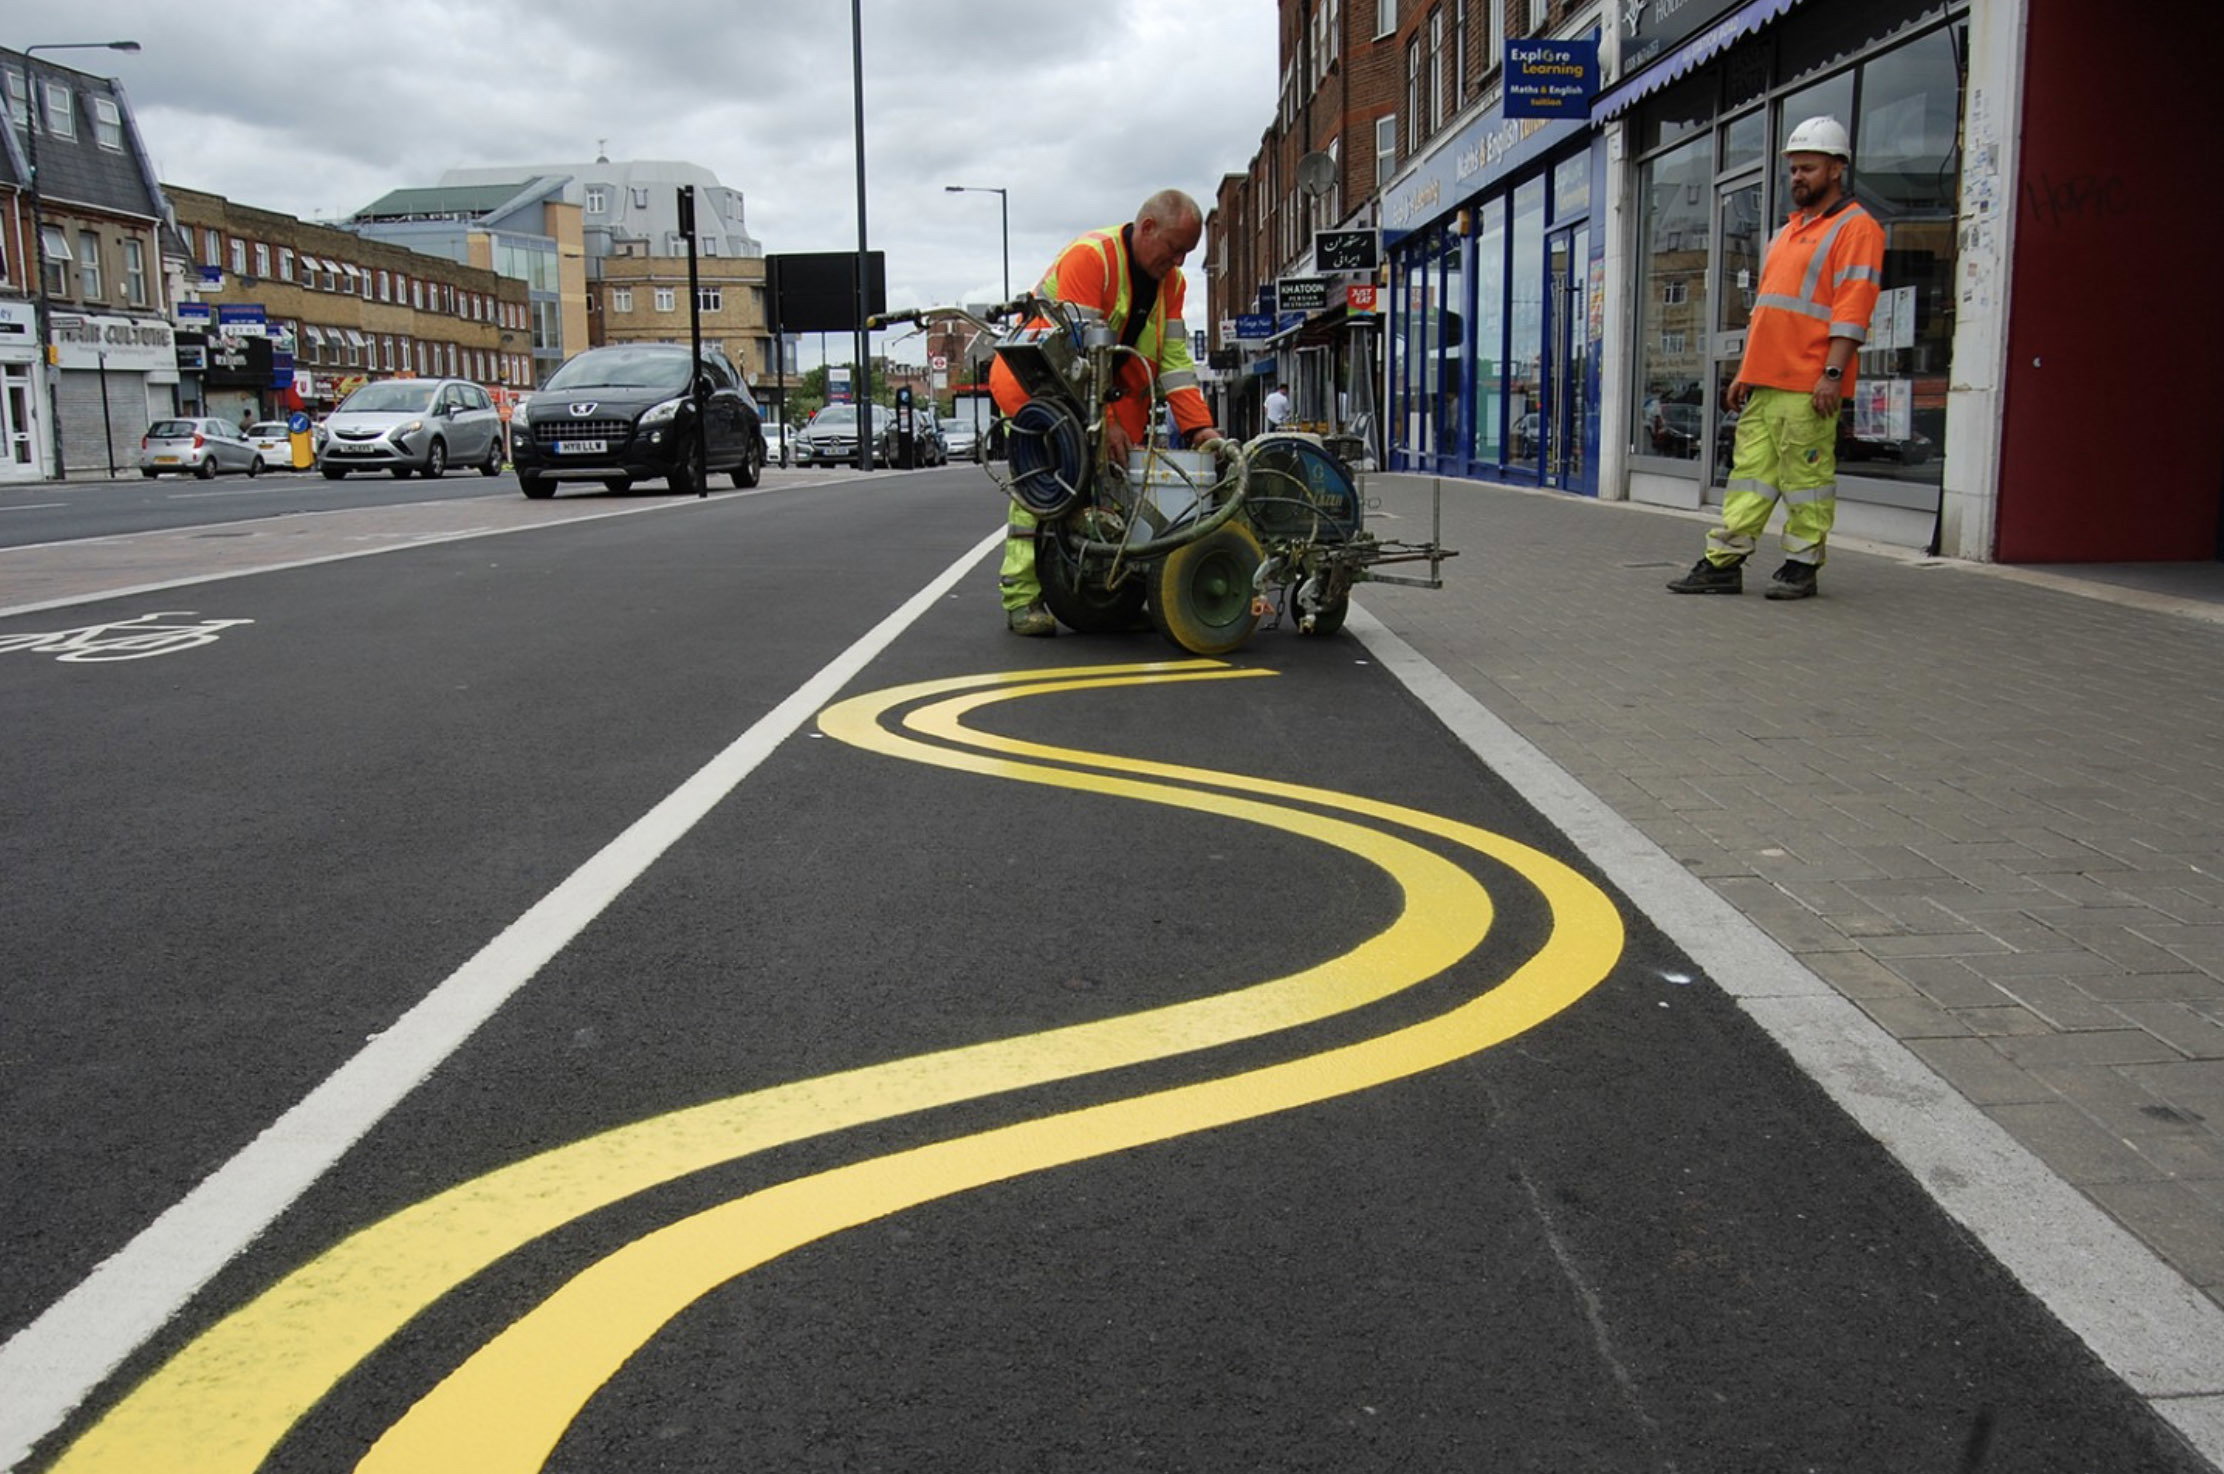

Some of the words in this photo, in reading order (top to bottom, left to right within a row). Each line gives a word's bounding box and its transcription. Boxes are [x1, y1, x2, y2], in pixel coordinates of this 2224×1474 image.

[1511, 48, 1571, 64] Explore
[1523, 62, 1584, 78] Learning
[1510, 85, 1538, 94] Maths
[1549, 85, 1583, 96] English
[1281, 284, 1325, 294] KHATOON
[1352, 288, 1373, 298] JUST
[1355, 296, 1372, 304] EAT
